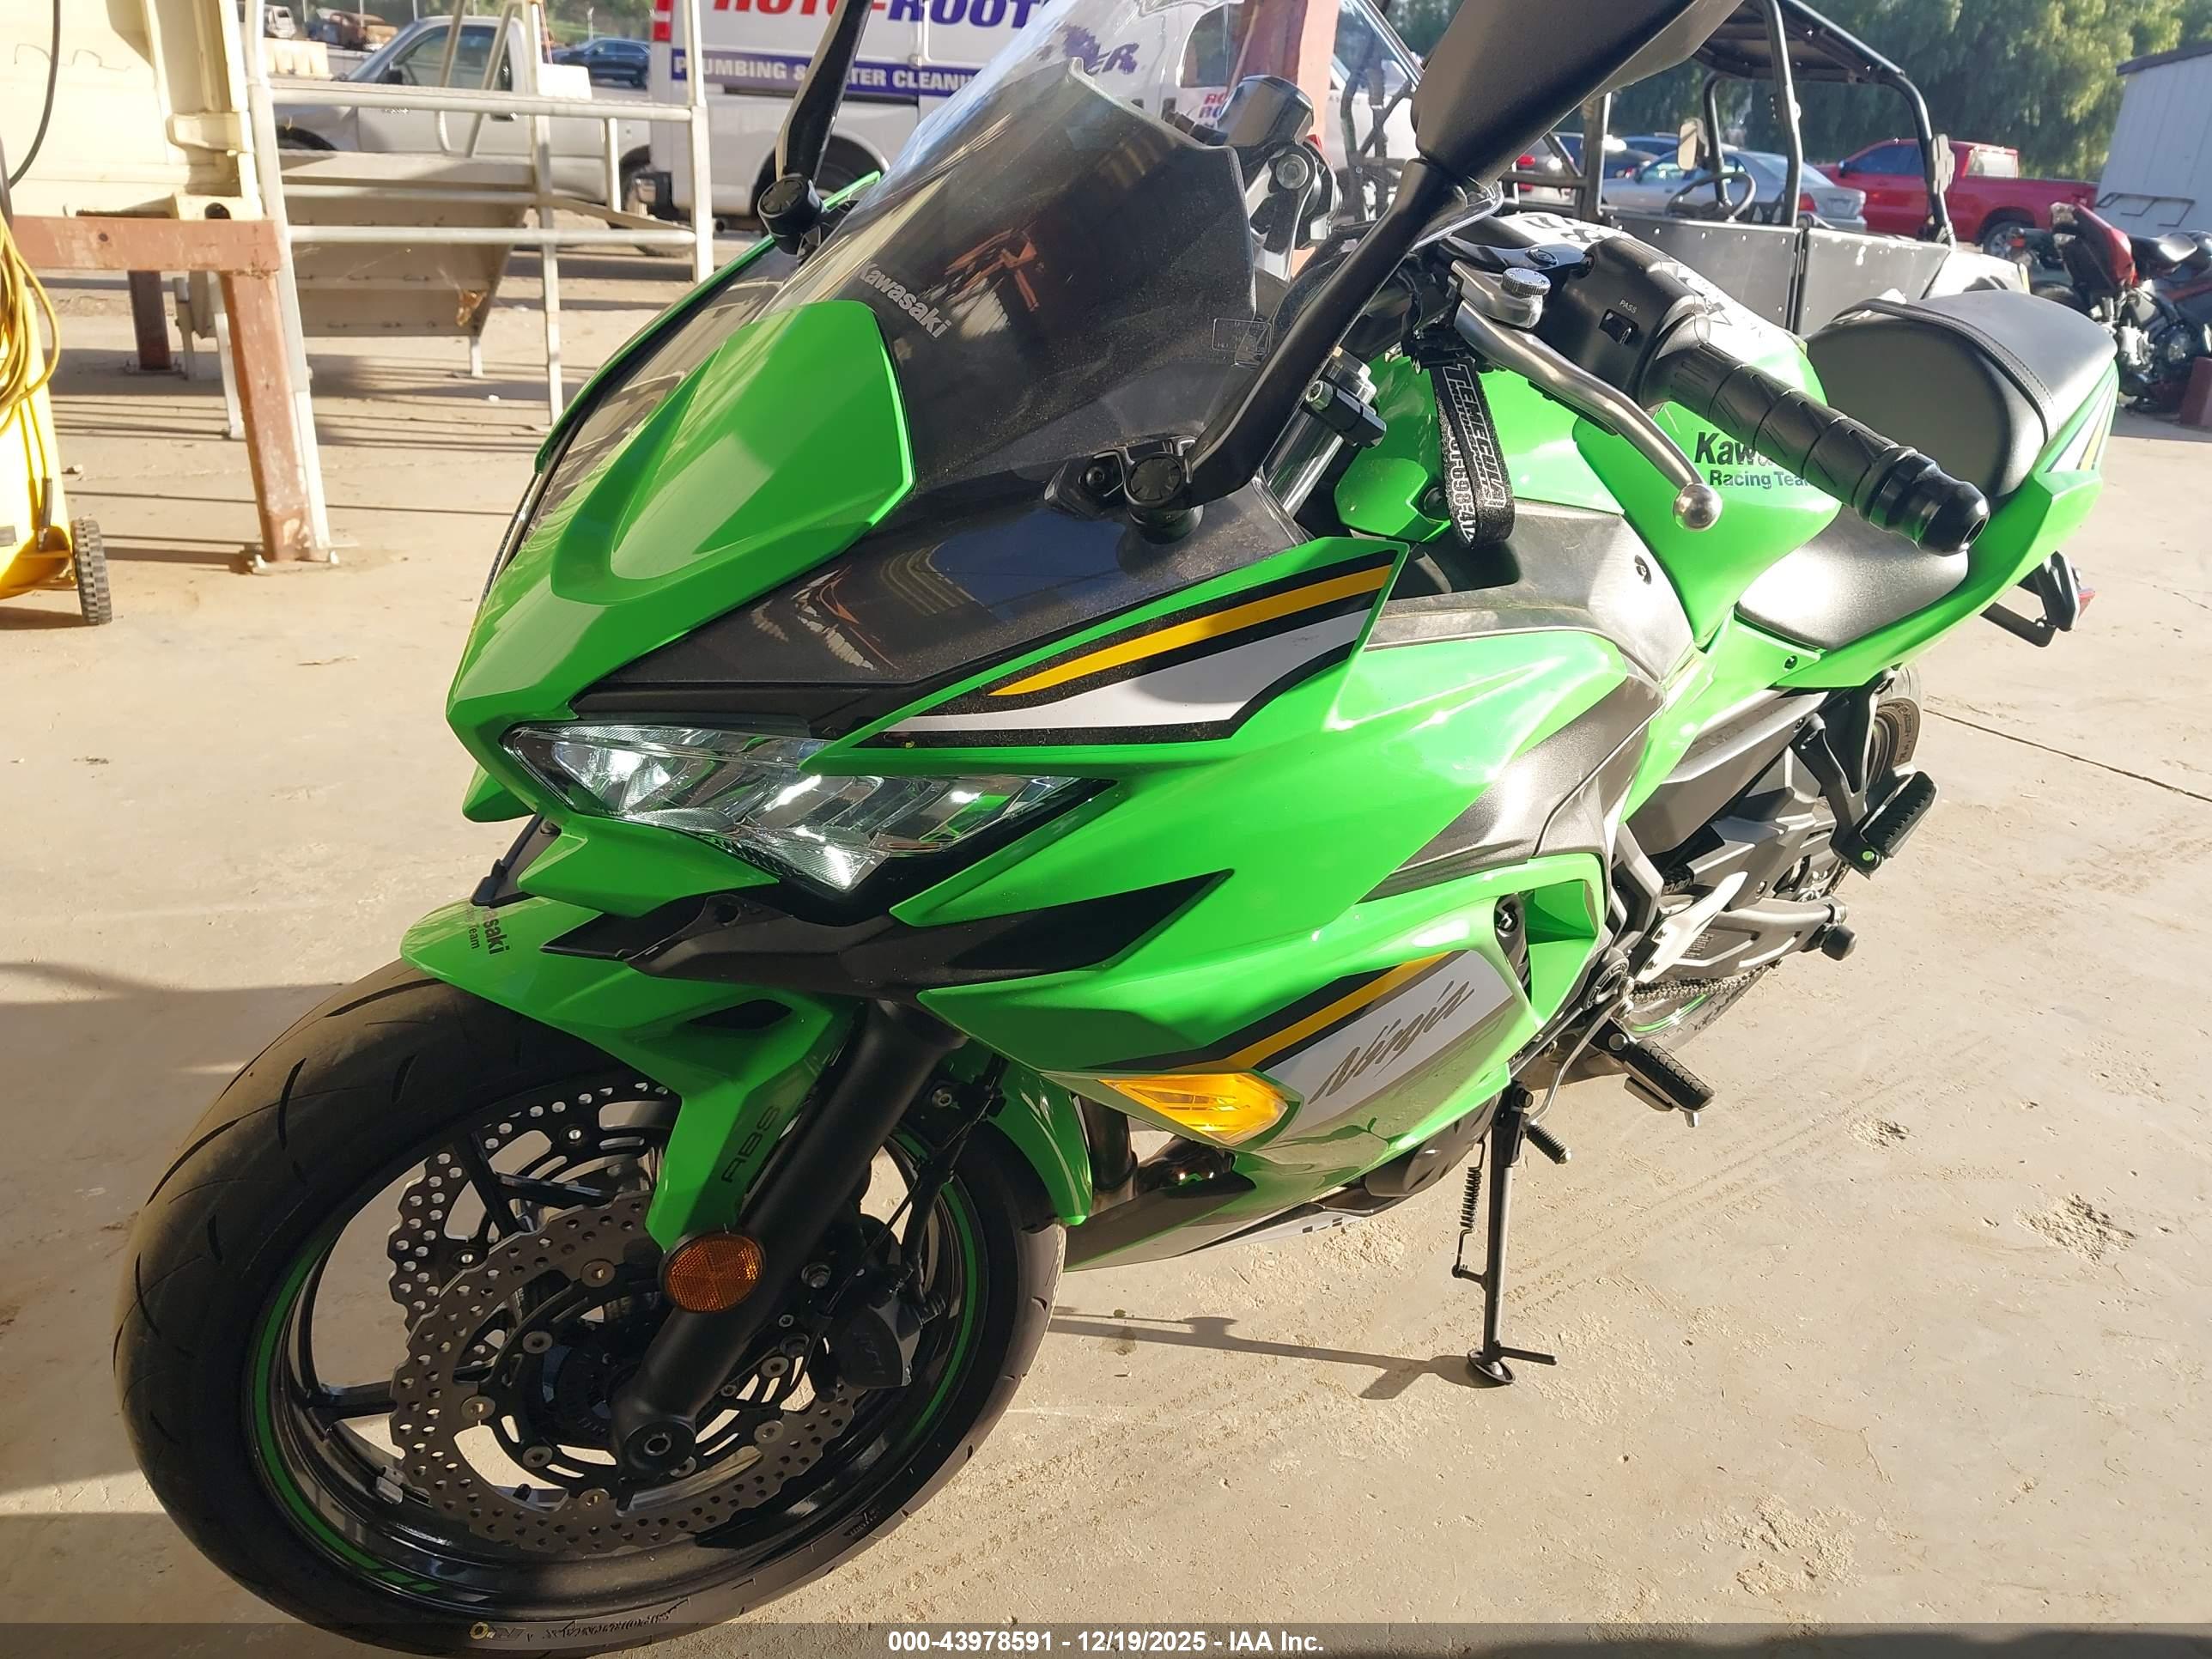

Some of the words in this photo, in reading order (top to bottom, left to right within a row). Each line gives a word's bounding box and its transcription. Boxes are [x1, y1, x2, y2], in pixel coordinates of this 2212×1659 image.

[673, 57, 787, 80] PUMBING
[858, 260, 952, 338] Kawasaki
[1619, 299, 1638, 314] PASS
[1442, 364, 1505, 500] TEMECULA
[1710, 470, 1772, 489] Racing
[1308, 980, 1474, 1105] Ninja
[720, 1105, 781, 1183] ABS
